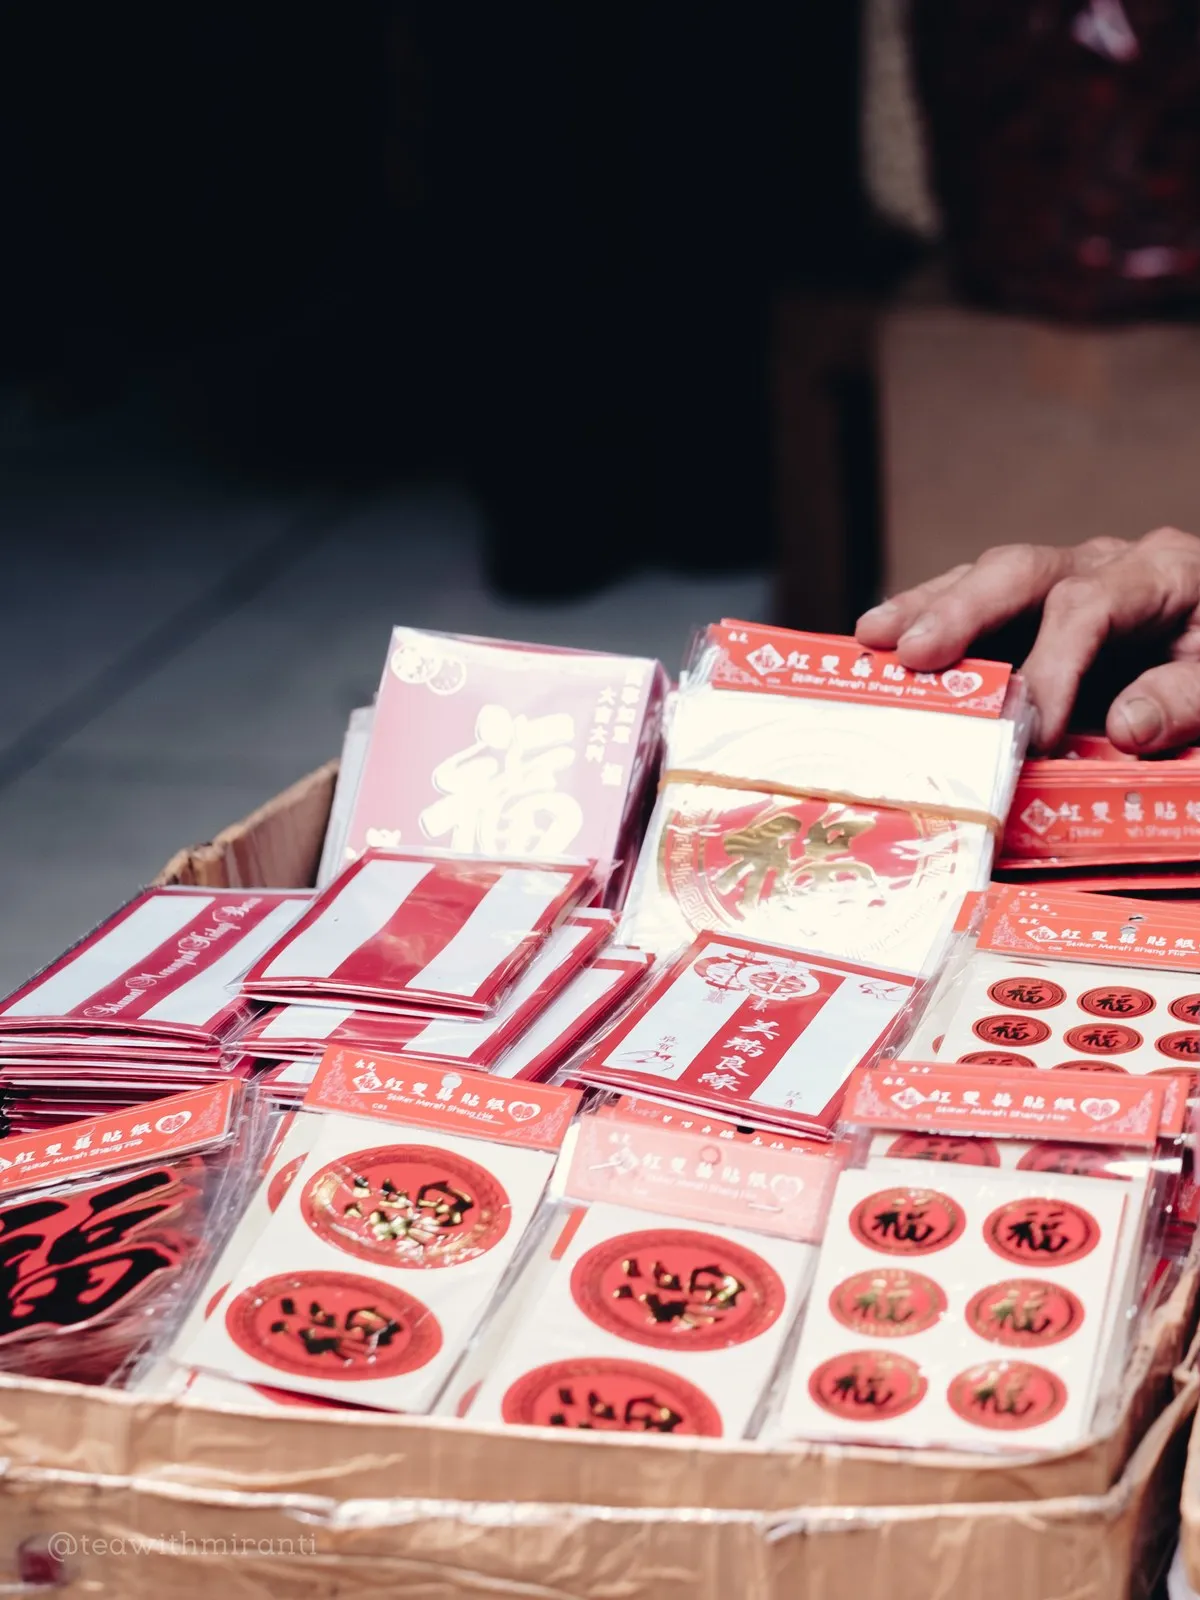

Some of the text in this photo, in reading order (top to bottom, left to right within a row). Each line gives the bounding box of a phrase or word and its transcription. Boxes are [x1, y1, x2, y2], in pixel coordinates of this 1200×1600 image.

[419, 703, 584, 855] 福
[1098, 943, 1132, 952] Merah
[1005, 984, 1044, 1004] 福
[1096, 993, 1134, 1012] 福
[991, 1022, 1030, 1040] 福
[1082, 1030, 1121, 1048] 福
[415, 1098, 446, 1110] Merah
[53, 1151, 88, 1165] Merah
[872, 1197, 933, 1243] 福
[1006, 1211, 1069, 1253] 福
[853, 1278, 914, 1324] 福
[990, 1289, 1051, 1333] 福
[832, 1360, 893, 1405] 福
[971, 1370, 1033, 1416] 福
